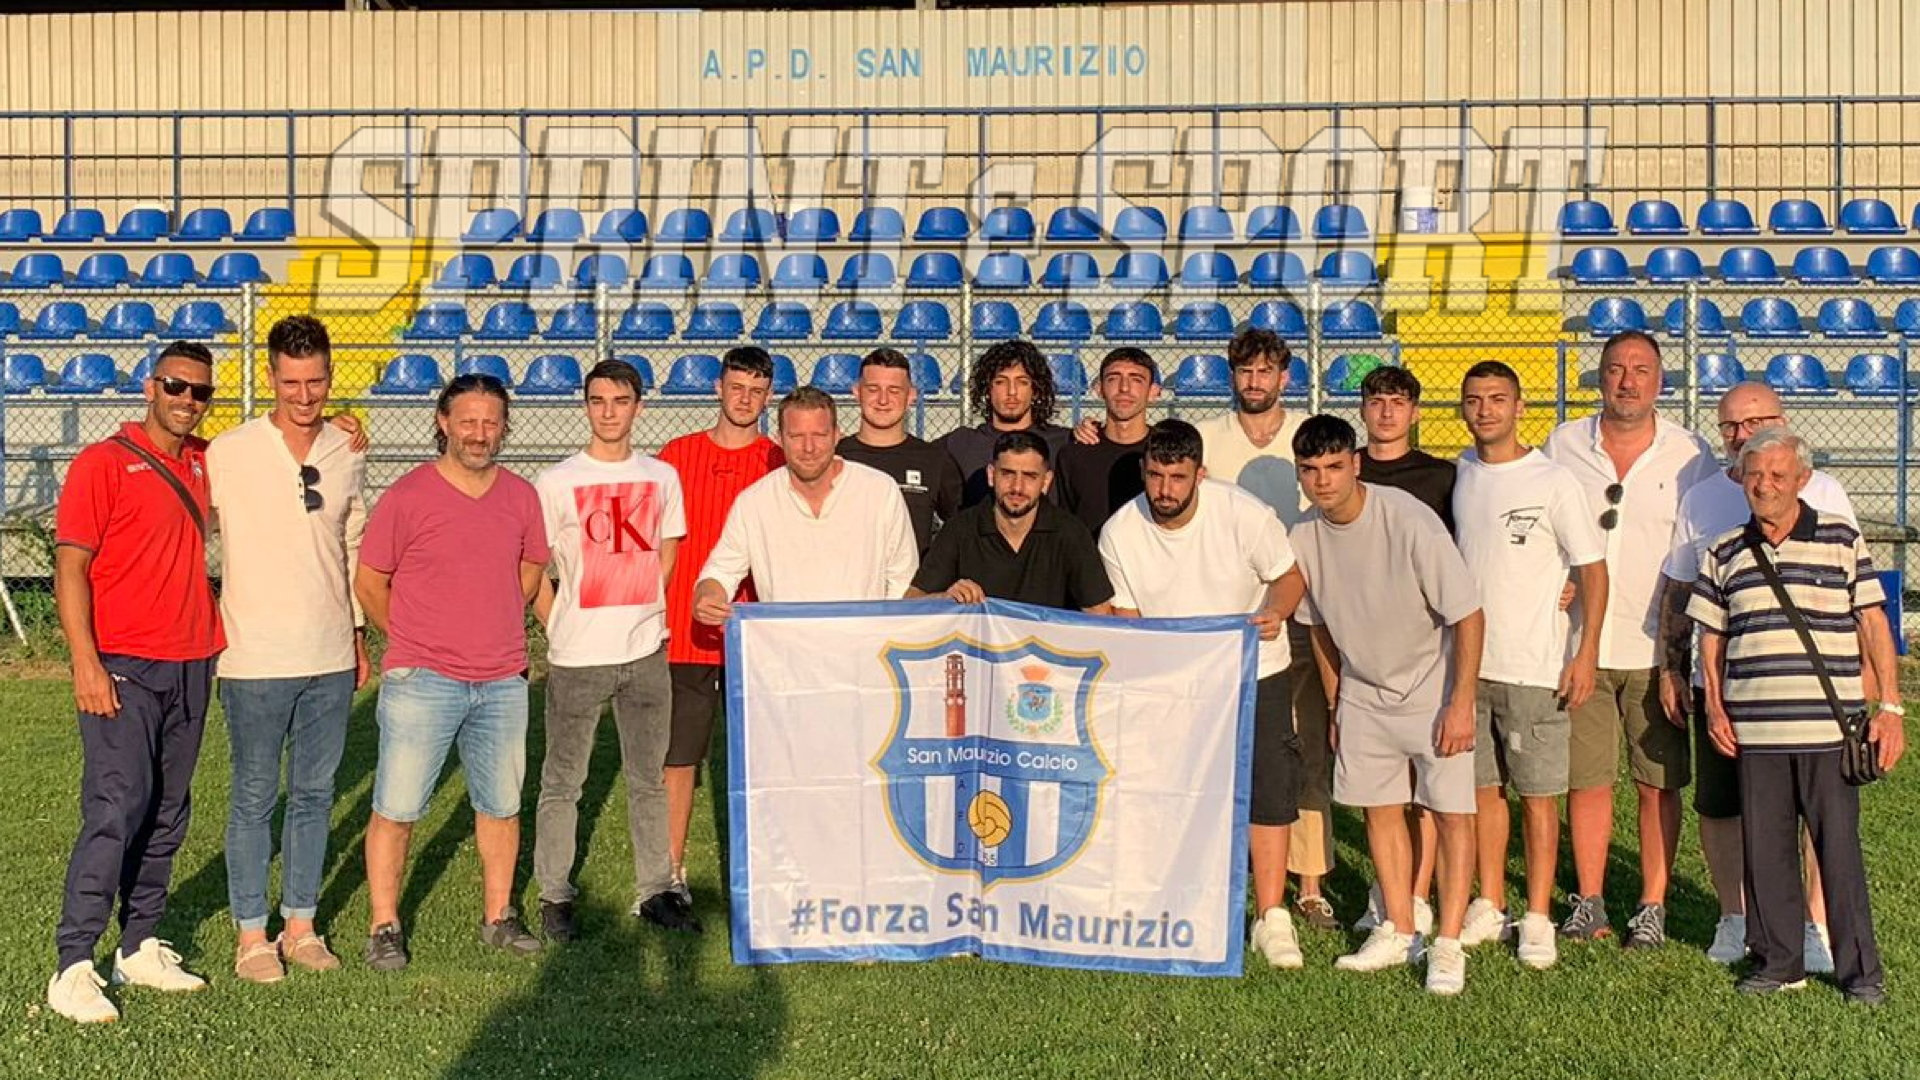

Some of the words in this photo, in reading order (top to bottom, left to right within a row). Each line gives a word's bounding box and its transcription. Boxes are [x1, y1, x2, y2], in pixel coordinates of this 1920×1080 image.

[857, 47, 922, 78] SAN
[966, 44, 1148, 78] MAURIZIO
[906, 747, 942, 764] San
[1016, 751, 1078, 771] Calcio
[789, 898, 929, 935] #Forza
[946, 892, 999, 933] San
[1019, 901, 1195, 949] Maurizio
